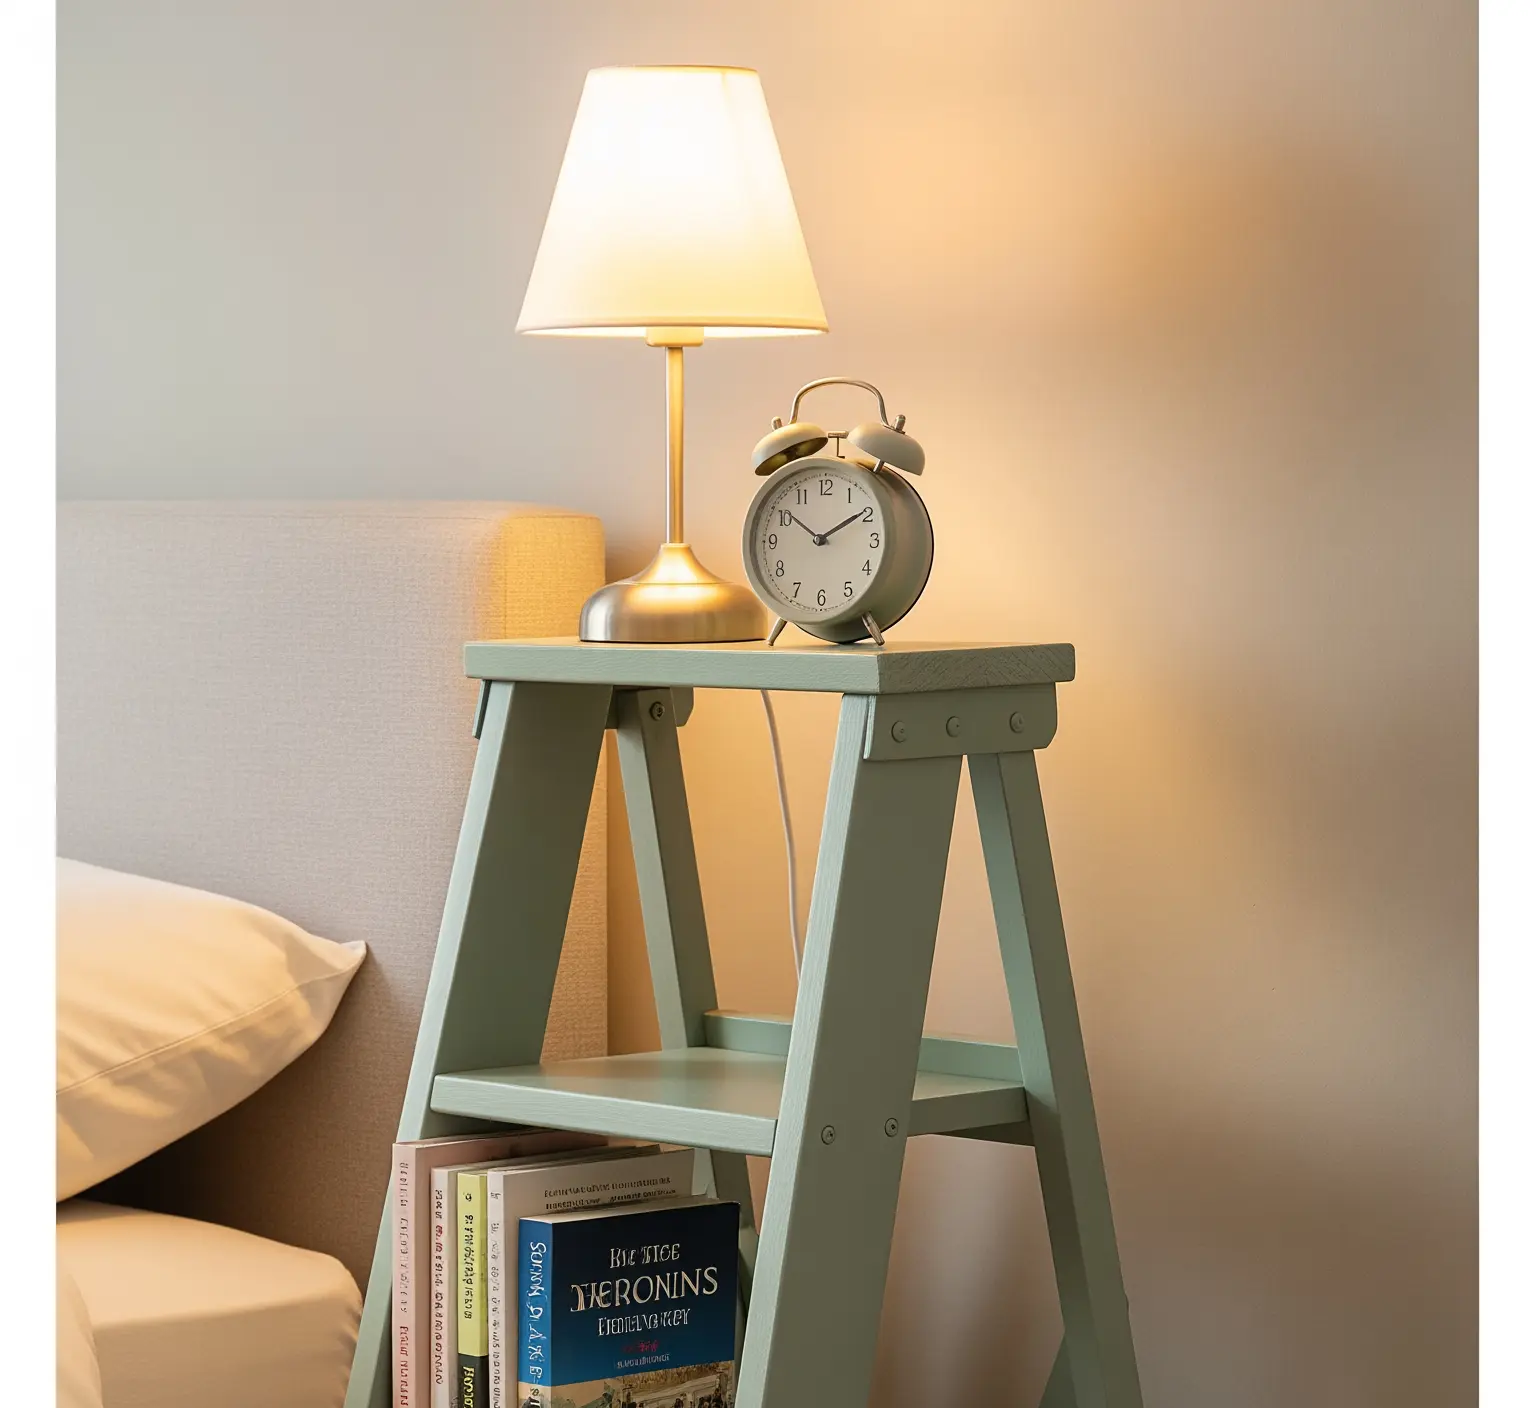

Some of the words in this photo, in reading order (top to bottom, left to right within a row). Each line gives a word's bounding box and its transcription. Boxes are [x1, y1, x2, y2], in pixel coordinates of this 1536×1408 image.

[818, 479, 832, 495] 12
[796, 489, 807, 504] 11
[847, 488, 852, 503] 1
[778, 510, 791, 527] 10
[862, 506, 873, 522] 2
[768, 534, 777, 548] 9
[869, 533, 879, 548] 3
[775, 560, 784, 576] 8
[861, 559, 871, 575] 4
[792, 582, 801, 598] 7
[816, 589, 826, 605] 6
[843, 581, 852, 597] 5
